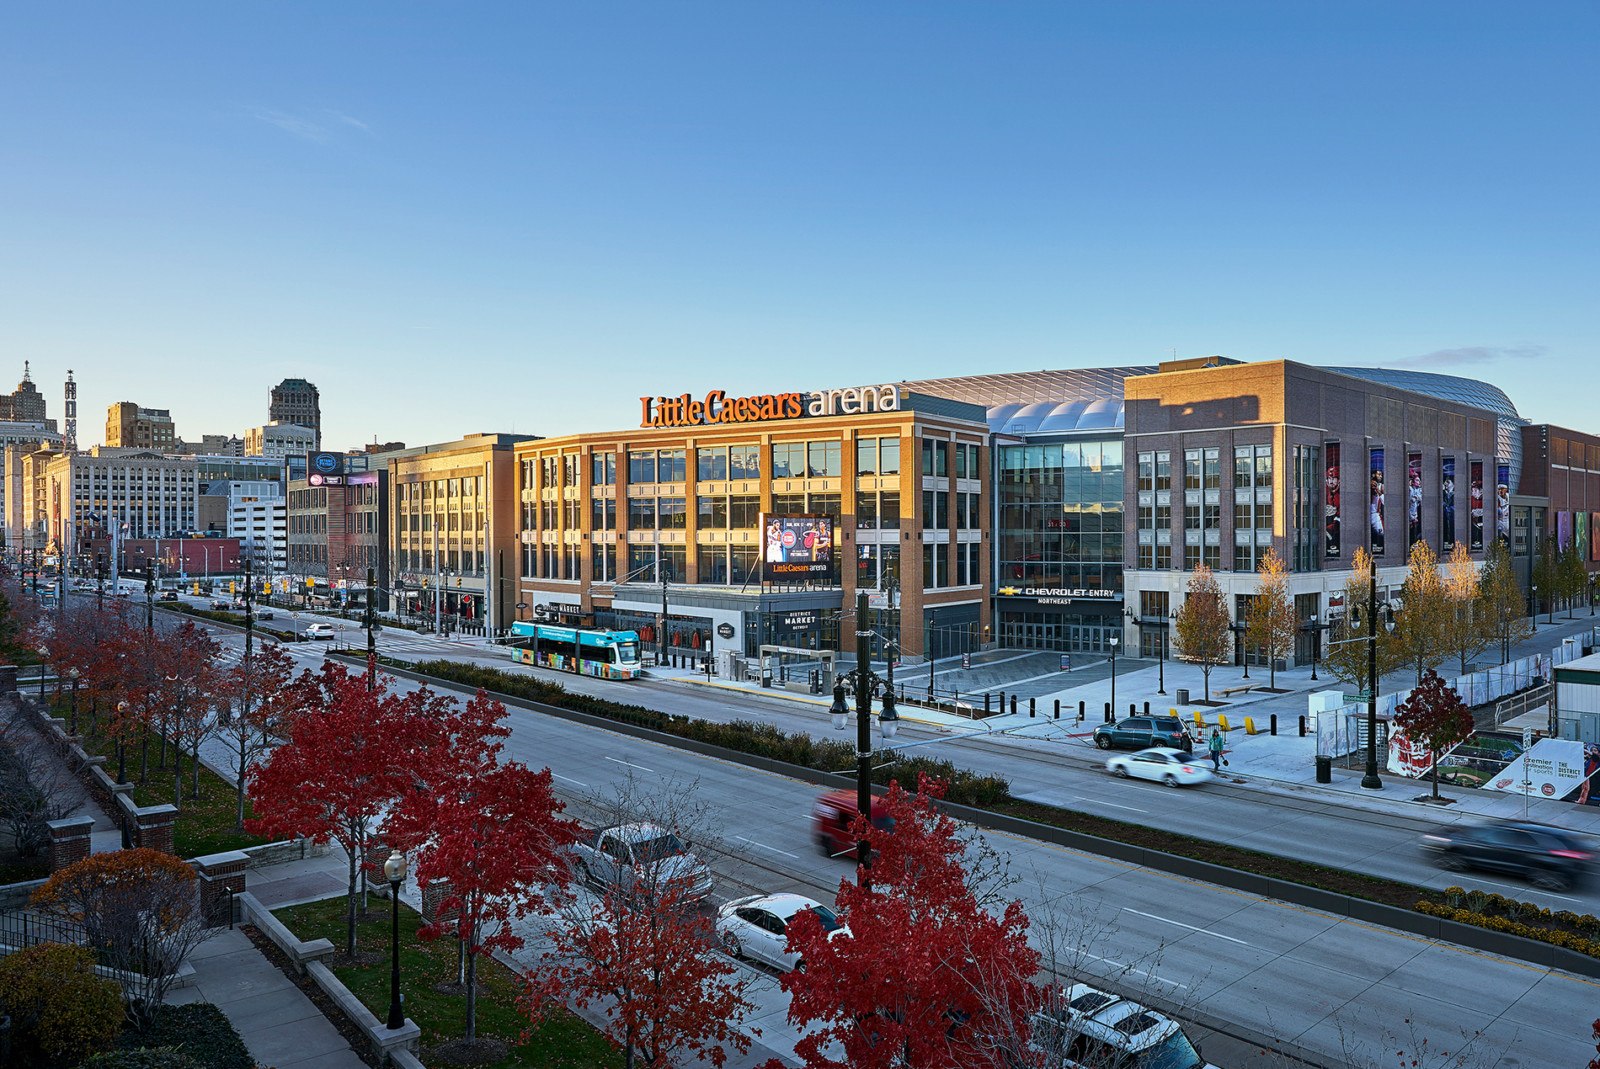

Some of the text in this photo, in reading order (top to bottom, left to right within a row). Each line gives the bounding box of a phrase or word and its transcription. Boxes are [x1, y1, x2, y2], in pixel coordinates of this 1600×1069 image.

[640, 384, 899, 428] Little Caesars arena
[773, 563, 827, 573] Little Caesars arena
[1025, 587, 1114, 597] CHEVROLET ENTRY
[559, 604, 580, 614] MARKET
[784, 616, 816, 625] MARKET
[1524, 739, 1530, 748] 30
[1558, 767, 1580, 775] DISTRICT
